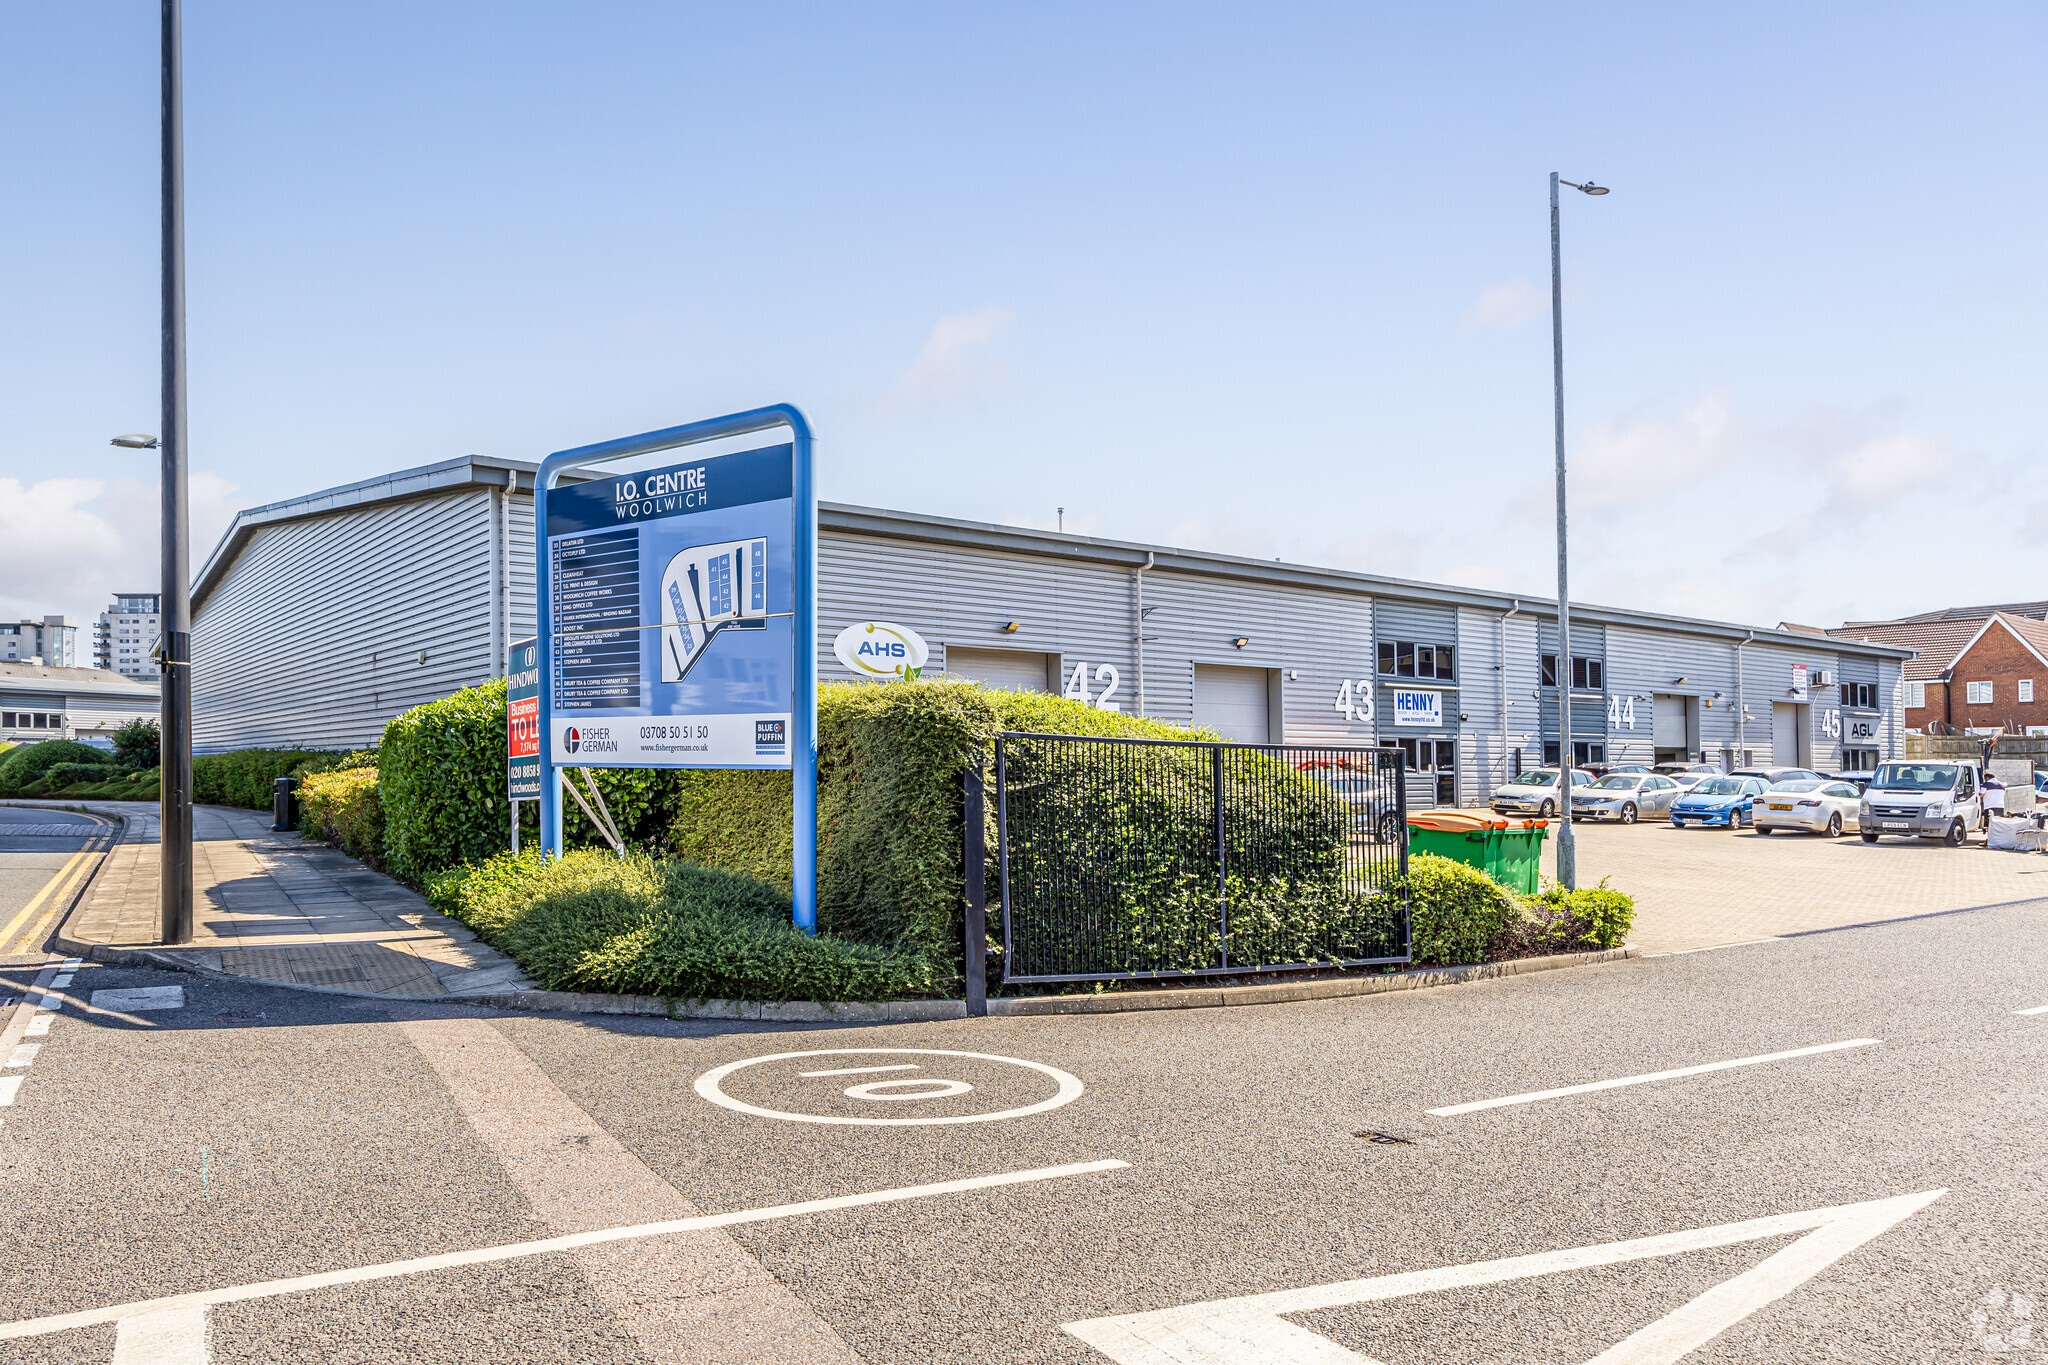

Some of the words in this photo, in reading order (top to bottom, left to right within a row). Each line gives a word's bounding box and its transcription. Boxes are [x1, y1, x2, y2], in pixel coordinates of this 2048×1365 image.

[616, 480, 640, 502] I.O.
[644, 466, 706, 496] CENTRE
[616, 491, 707, 519] WOOLWICH
[857, 641, 906, 658] AHS
[1064, 662, 1120, 712] 42
[1334, 680, 1374, 722] 43
[1397, 692, 1434, 711] HENNY
[512, 702, 536, 716] Business
[1608, 695, 1636, 730] 44
[512, 718, 527, 741] TO
[758, 724, 773, 732] BLUE
[1822, 709, 1840, 738] 45
[1851, 722, 1873, 737] AGL
[582, 728, 610, 740] FISHER
[640, 726, 666, 739] 03708
[669, 726, 680, 739] 50
[683, 726, 693, 739] 51
[697, 726, 708, 738] 50
[758, 733, 782, 741] PUFFIN
[520, 742, 531, 754] 7,174
[582, 740, 618, 752] GERMAN
[640, 743, 708, 753] www.fishergerman.co.uk
[511, 766, 522, 779] 020
